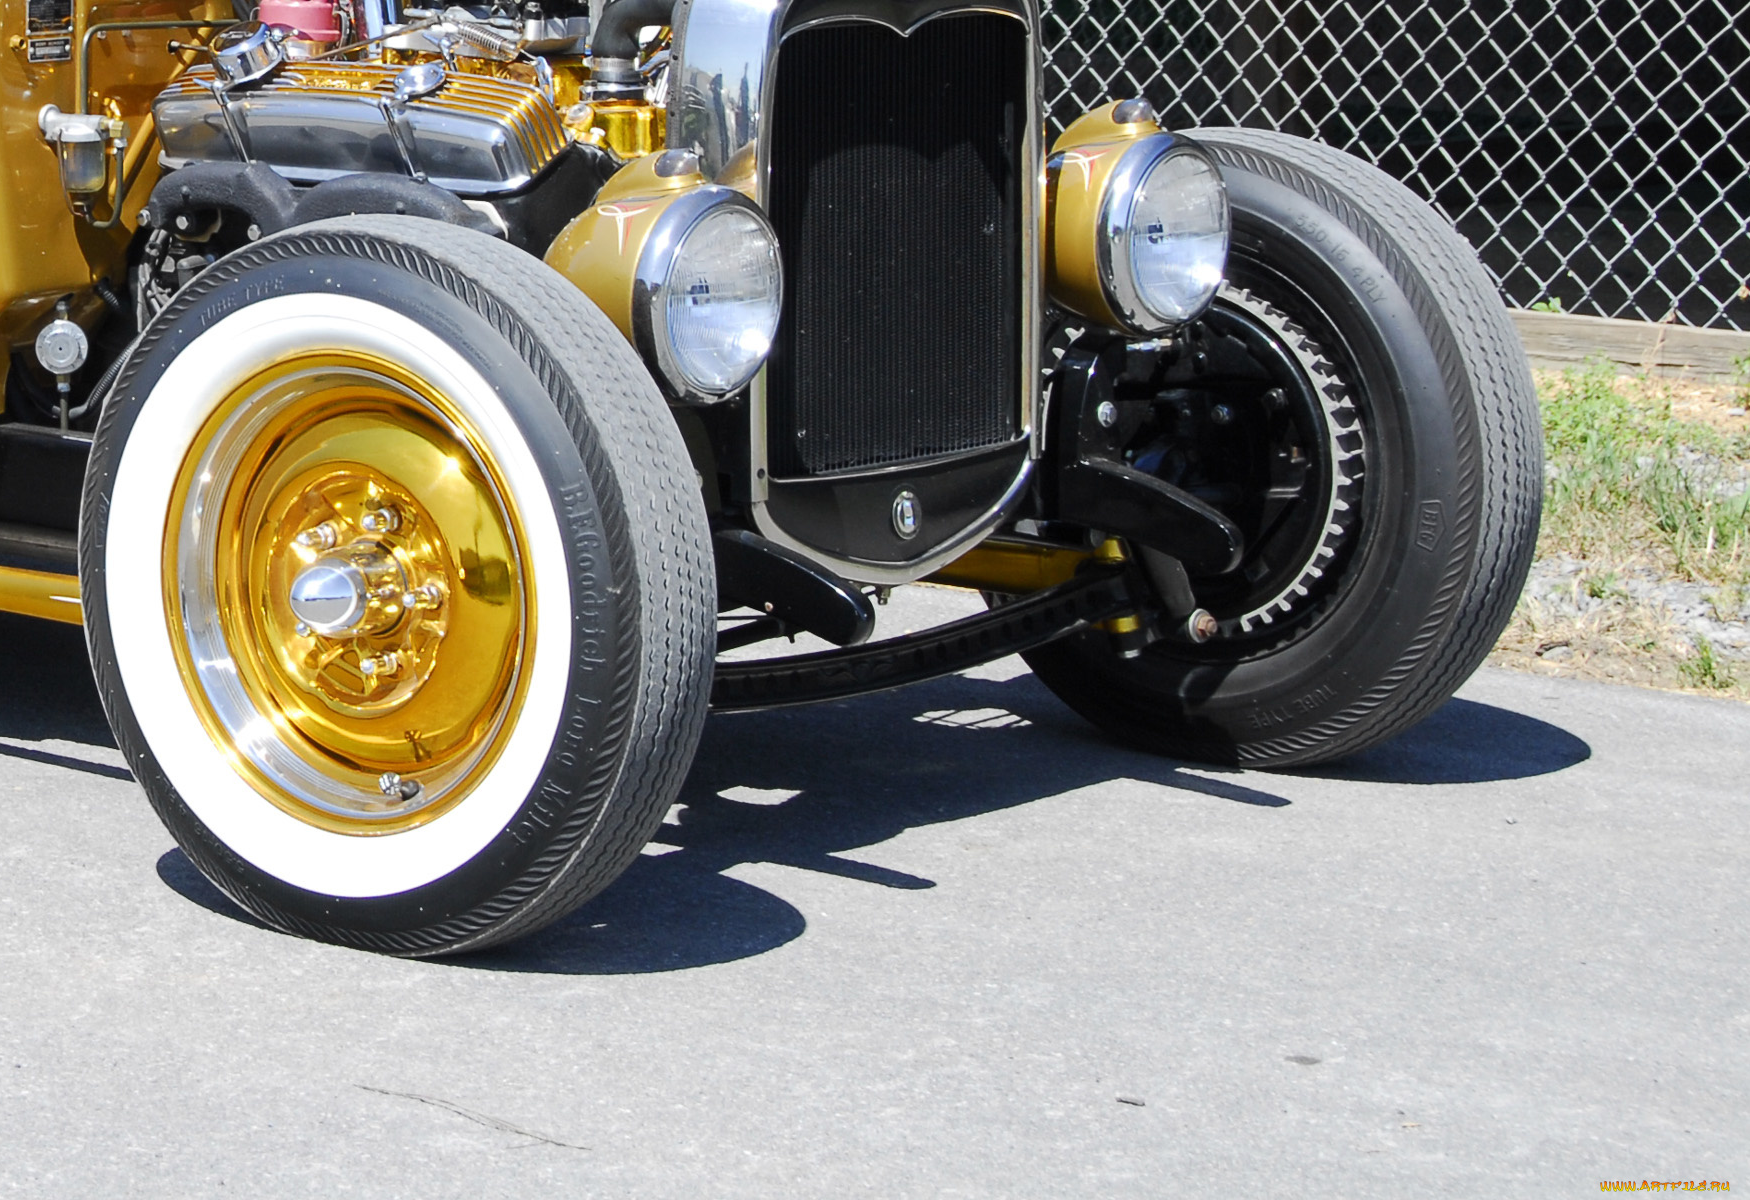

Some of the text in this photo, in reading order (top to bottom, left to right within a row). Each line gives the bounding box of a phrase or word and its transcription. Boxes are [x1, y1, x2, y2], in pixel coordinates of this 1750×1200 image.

[199, 274, 285, 326] TUBE TYPE
[1419, 508, 1440, 541] BFG
[555, 693, 602, 767] Long
[1247, 684, 1338, 729] TUBE TYPE
[512, 779, 571, 846] Miler
